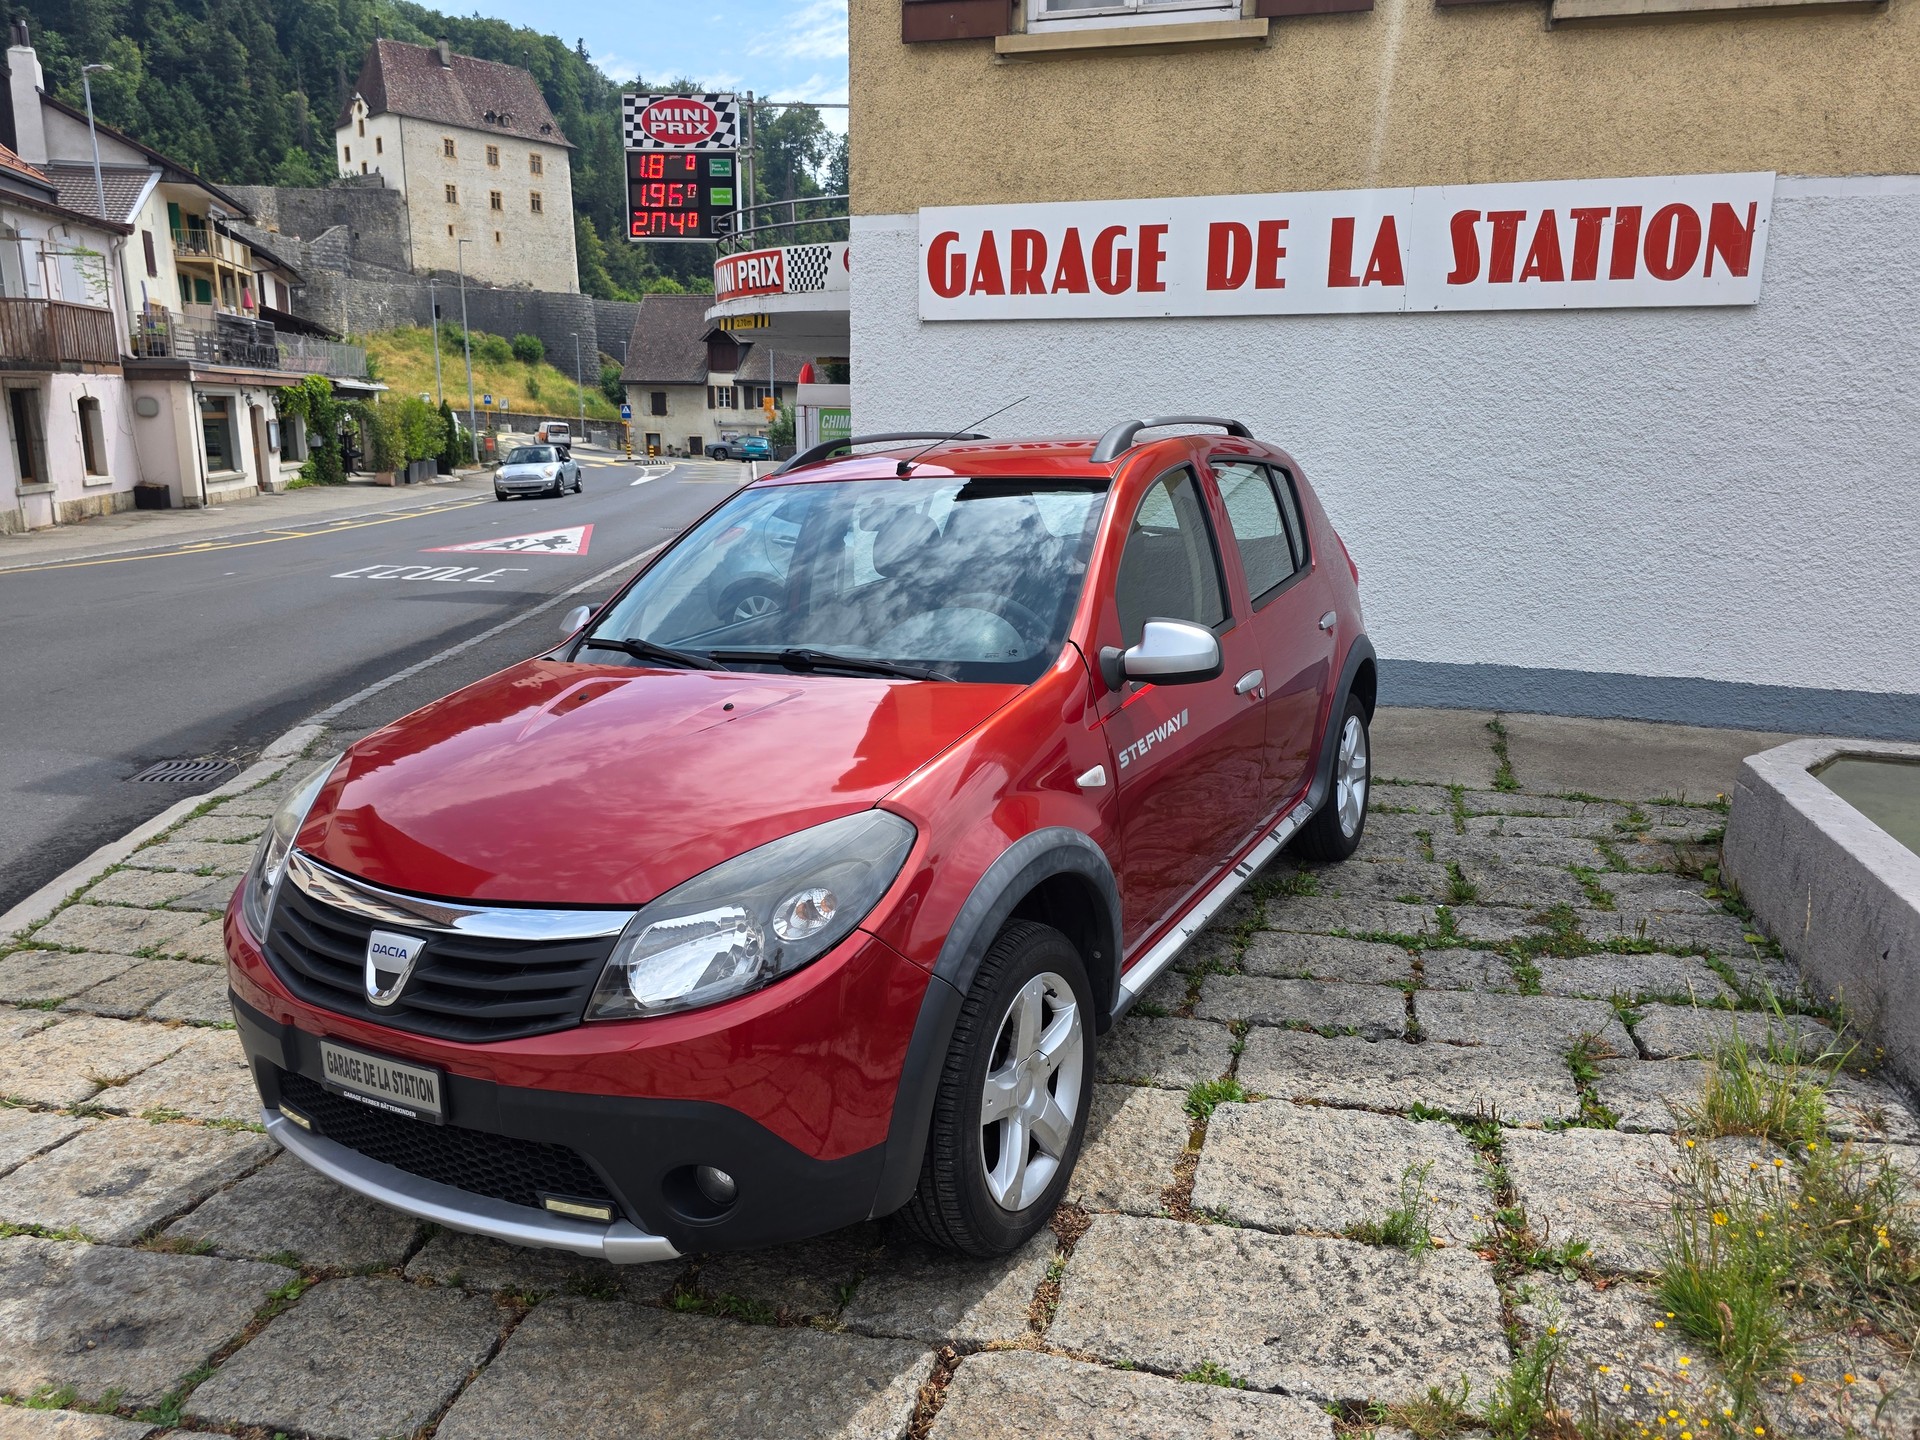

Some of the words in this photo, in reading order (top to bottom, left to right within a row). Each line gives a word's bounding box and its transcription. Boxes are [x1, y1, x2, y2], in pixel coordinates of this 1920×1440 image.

[650, 109, 709, 121] MINI
[650, 122, 711, 135] PRIX
[926, 225, 1169, 299] GARAGE
[1207, 219, 1290, 291] DE
[1328, 215, 1406, 288] LA
[1447, 202, 1757, 285] STATION
[716, 263, 735, 295] MINI
[737, 256, 782, 291] PRIX
[822, 414, 851, 429] CHIM
[330, 565, 529, 583] ECOLE
[1119, 713, 1180, 769] STEPWAY
[372, 943, 407, 959] DACIA
[327, 1050, 362, 1084] GARAGE
[363, 1062, 377, 1087] DE
[377, 1066, 391, 1092] LA
[392, 1070, 435, 1103] STATION
[343, 1091, 362, 1102] GARAGE
[362, 1097, 380, 1108] GERBER
